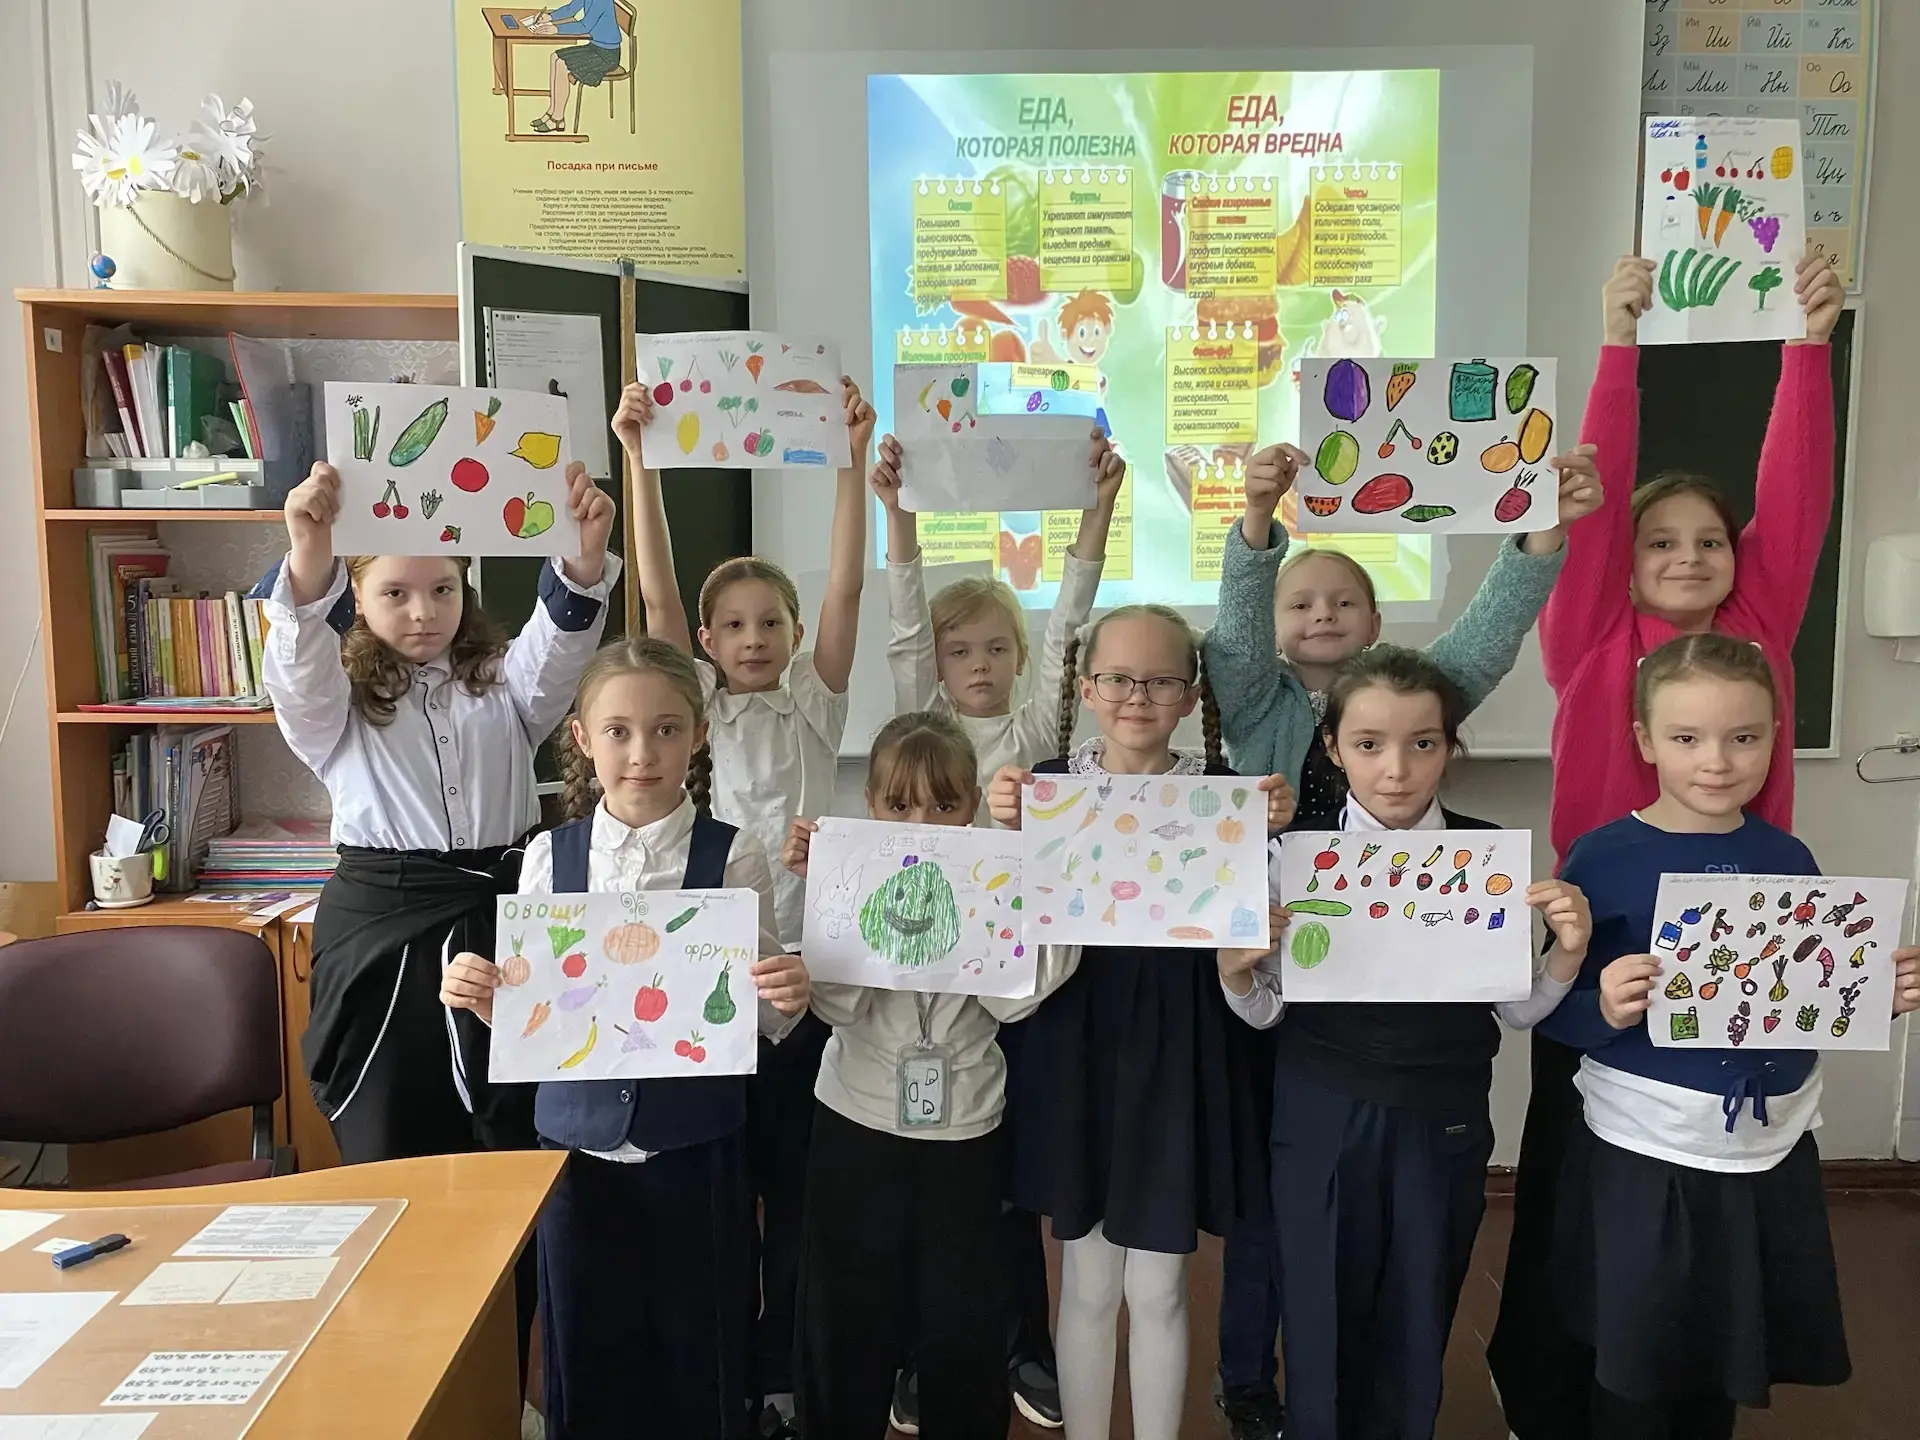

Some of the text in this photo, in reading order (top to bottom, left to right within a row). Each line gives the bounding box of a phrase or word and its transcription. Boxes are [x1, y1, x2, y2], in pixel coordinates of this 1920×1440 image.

[1649, 24, 1670, 56] Зз
[1704, 25, 1731, 49] Ии
[1766, 23, 1792, 49] Йй
[1827, 27, 1854, 50] Кк
[1683, 61, 1700, 72] Мм
[1806, 62, 1821, 73] Оо
[1641, 70, 1668, 92] Лл
[1686, 71, 1728, 93] Мм
[1760, 70, 1789, 93] Нн
[1829, 70, 1852, 93] Оо
[1018, 97, 1074, 128] ЕДА,
[1227, 95, 1284, 127] ЕДА,
[1806, 113, 1849, 137] Тт
[956, 135, 1136, 158] КОТОРАЯ ПОЛЕЗНА
[1169, 132, 1343, 158] КОТОРАЯ ВРЕДНА
[547, 161, 658, 173] Посадка при письме
[1816, 157, 1846, 185] Цц
[1314, 202, 1400, 214] Содержат чрезмерное
[1042, 211, 1085, 222] Укрепляют
[1314, 217, 1383, 228] количество соли,
[916, 218, 960, 229] Повышают
[1042, 226, 1115, 237] улучшают память,
[1189, 230, 1276, 241] Полностью химический
[1314, 231, 1339, 242] жиров
[1340, 232, 1345, 240] и
[1042, 239, 1111, 251] выводят вредные
[1189, 246, 1221, 258] продукт
[1042, 253, 1131, 266] вещества из организма
[1189, 260, 1257, 271] вкусовые добавки,
[1314, 260, 1373, 271] способствуют
[1189, 275, 1258, 286] красители и много
[1189, 289, 1216, 301] сахара)
[1018, 366, 1055, 378] пищеваре
[1173, 364, 1254, 376] Высокое содержание
[1173, 379, 1250, 390] соли, жира и сахара,
[1173, 393, 1230, 404] консервантов,
[1173, 408, 1218, 417] химических
[1173, 420, 1240, 432] ароматизаторов
[918, 540, 953, 552] одержат
